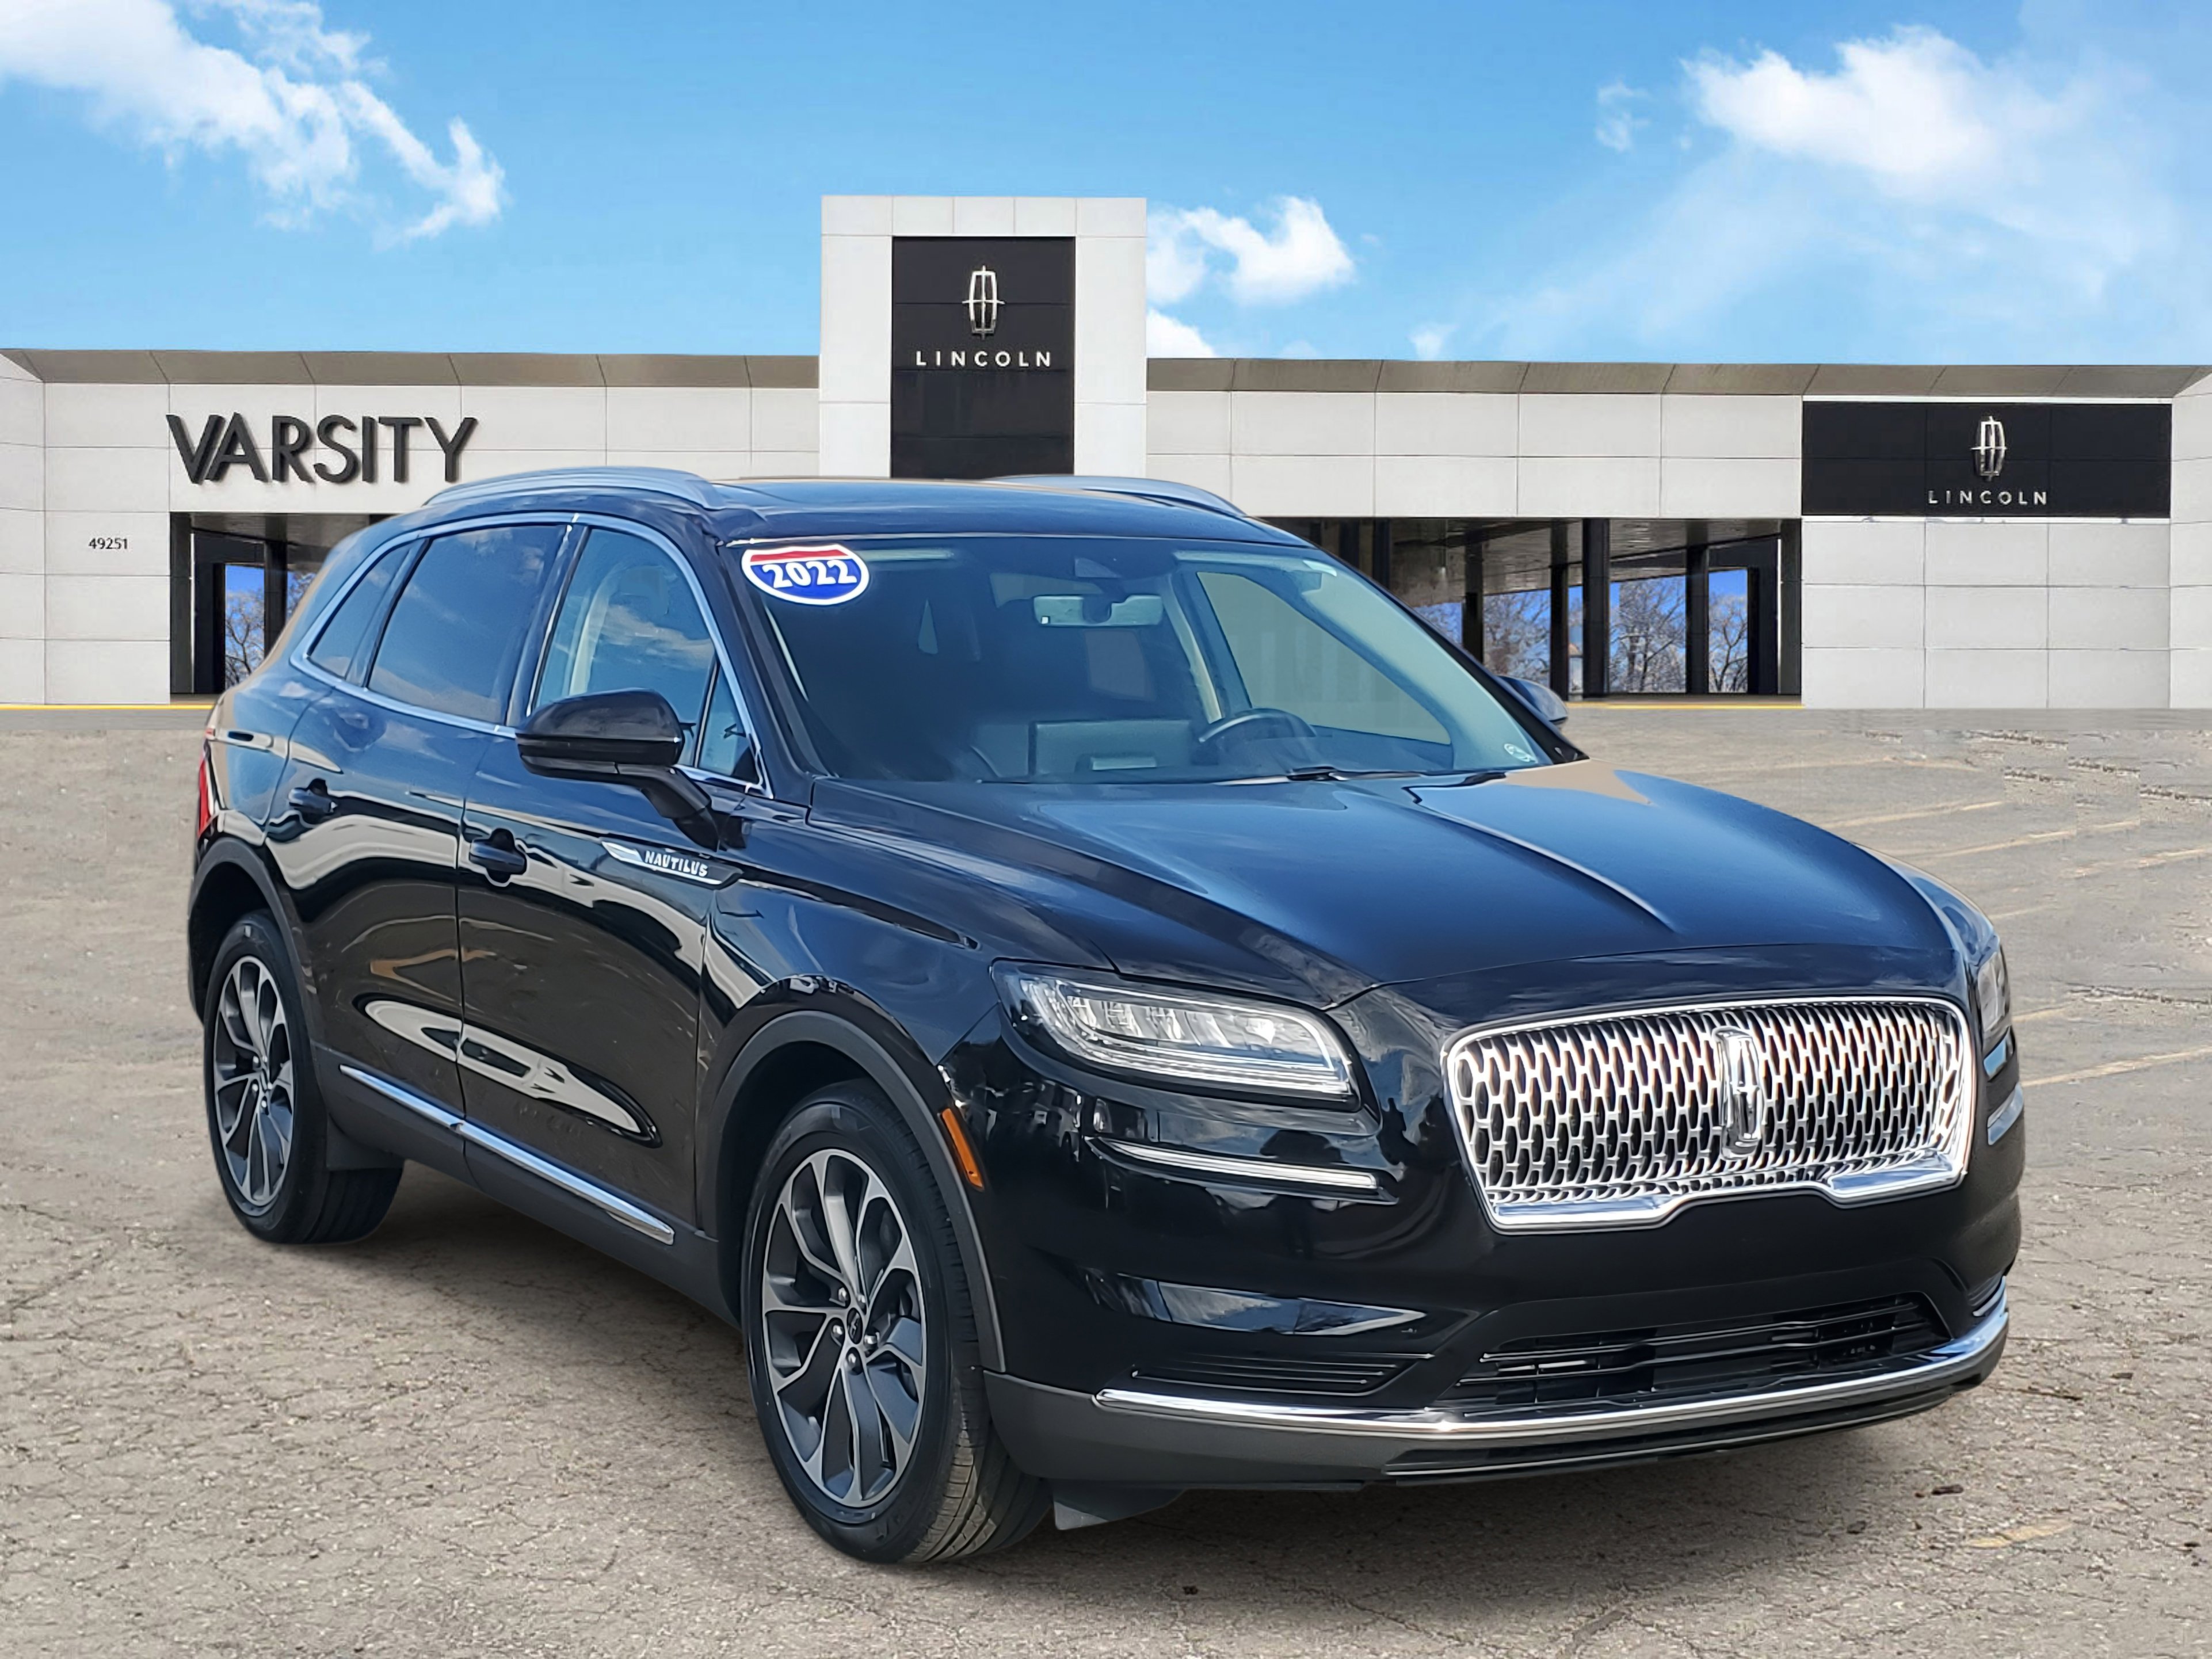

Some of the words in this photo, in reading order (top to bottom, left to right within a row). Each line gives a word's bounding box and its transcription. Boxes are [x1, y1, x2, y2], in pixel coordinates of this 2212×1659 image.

[916, 350, 1051, 367] LINCOLN
[166, 412, 478, 485] VARSITY
[1928, 490, 2047, 505] LINCOLN
[88, 537, 128, 550] 49251
[762, 559, 857, 588] 2022
[644, 851, 708, 877] NAUTILUS
